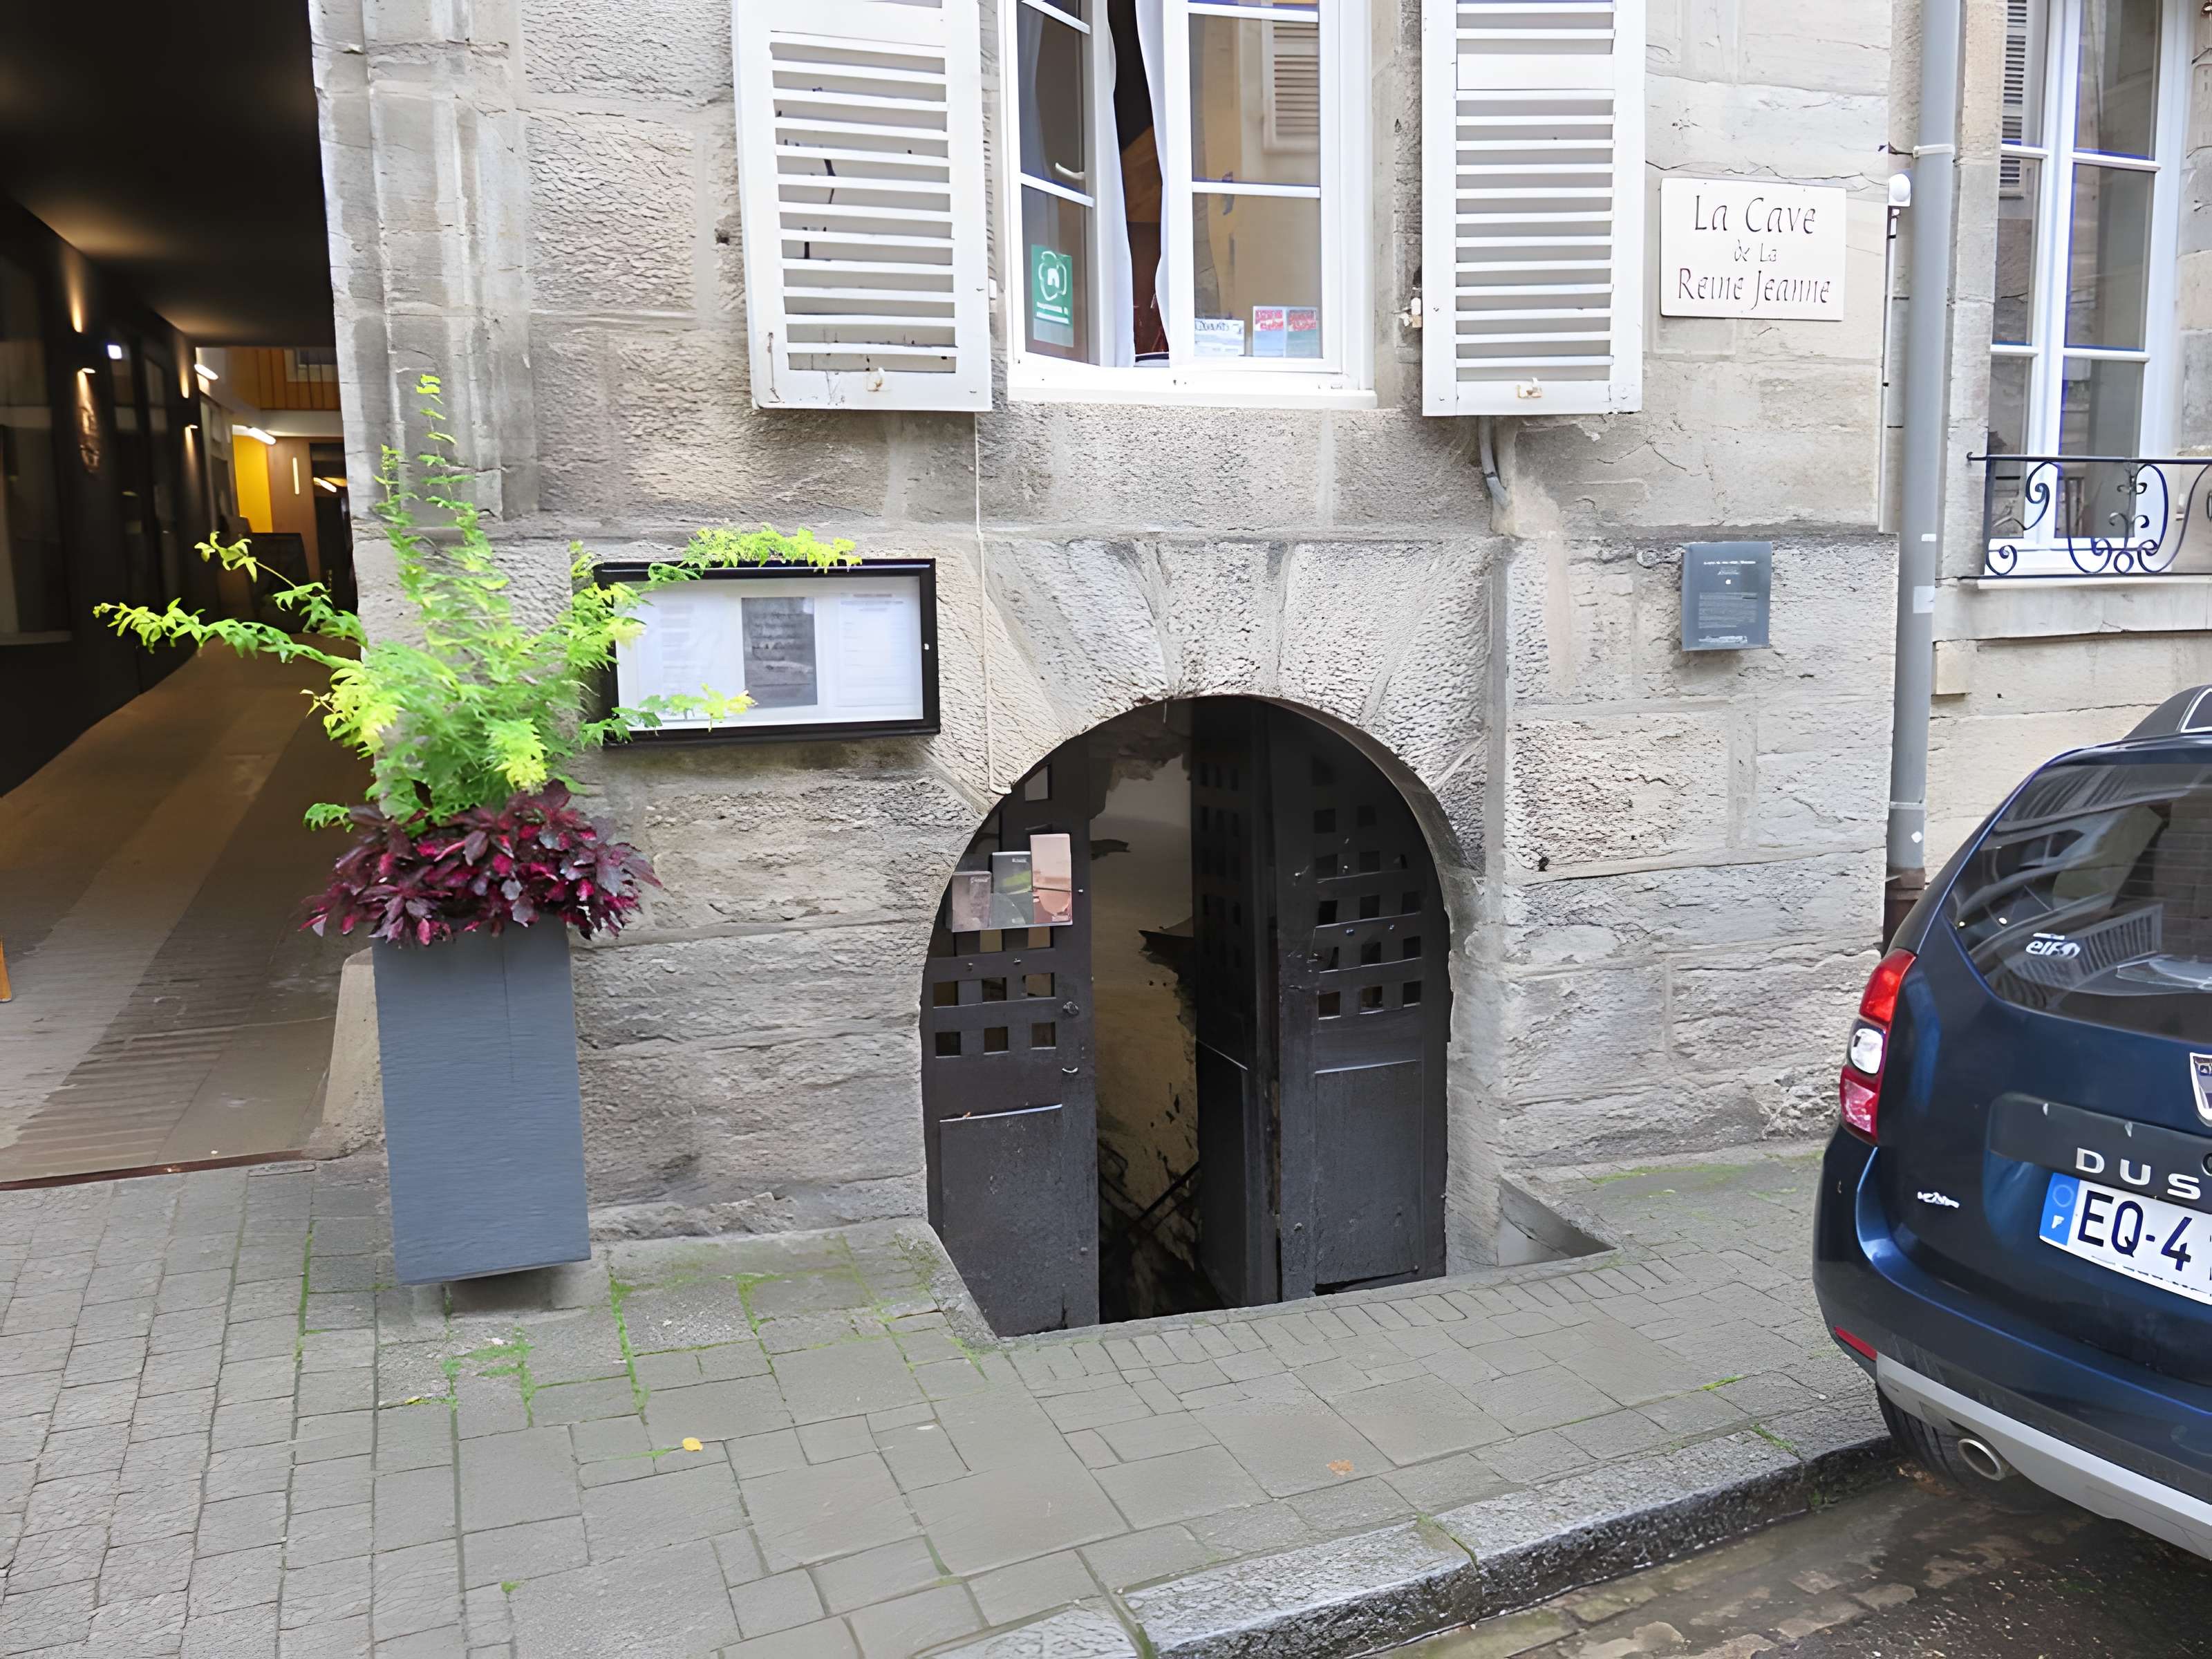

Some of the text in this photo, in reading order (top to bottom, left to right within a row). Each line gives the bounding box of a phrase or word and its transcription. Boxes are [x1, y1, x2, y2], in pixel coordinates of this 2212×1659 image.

[1694, 195, 1817, 234] La Cave
[1678, 268, 1831, 310] Reine Jeanne
[2075, 1147, 2202, 1201] DUS
[2077, 1189, 2212, 1281] EQ-4
